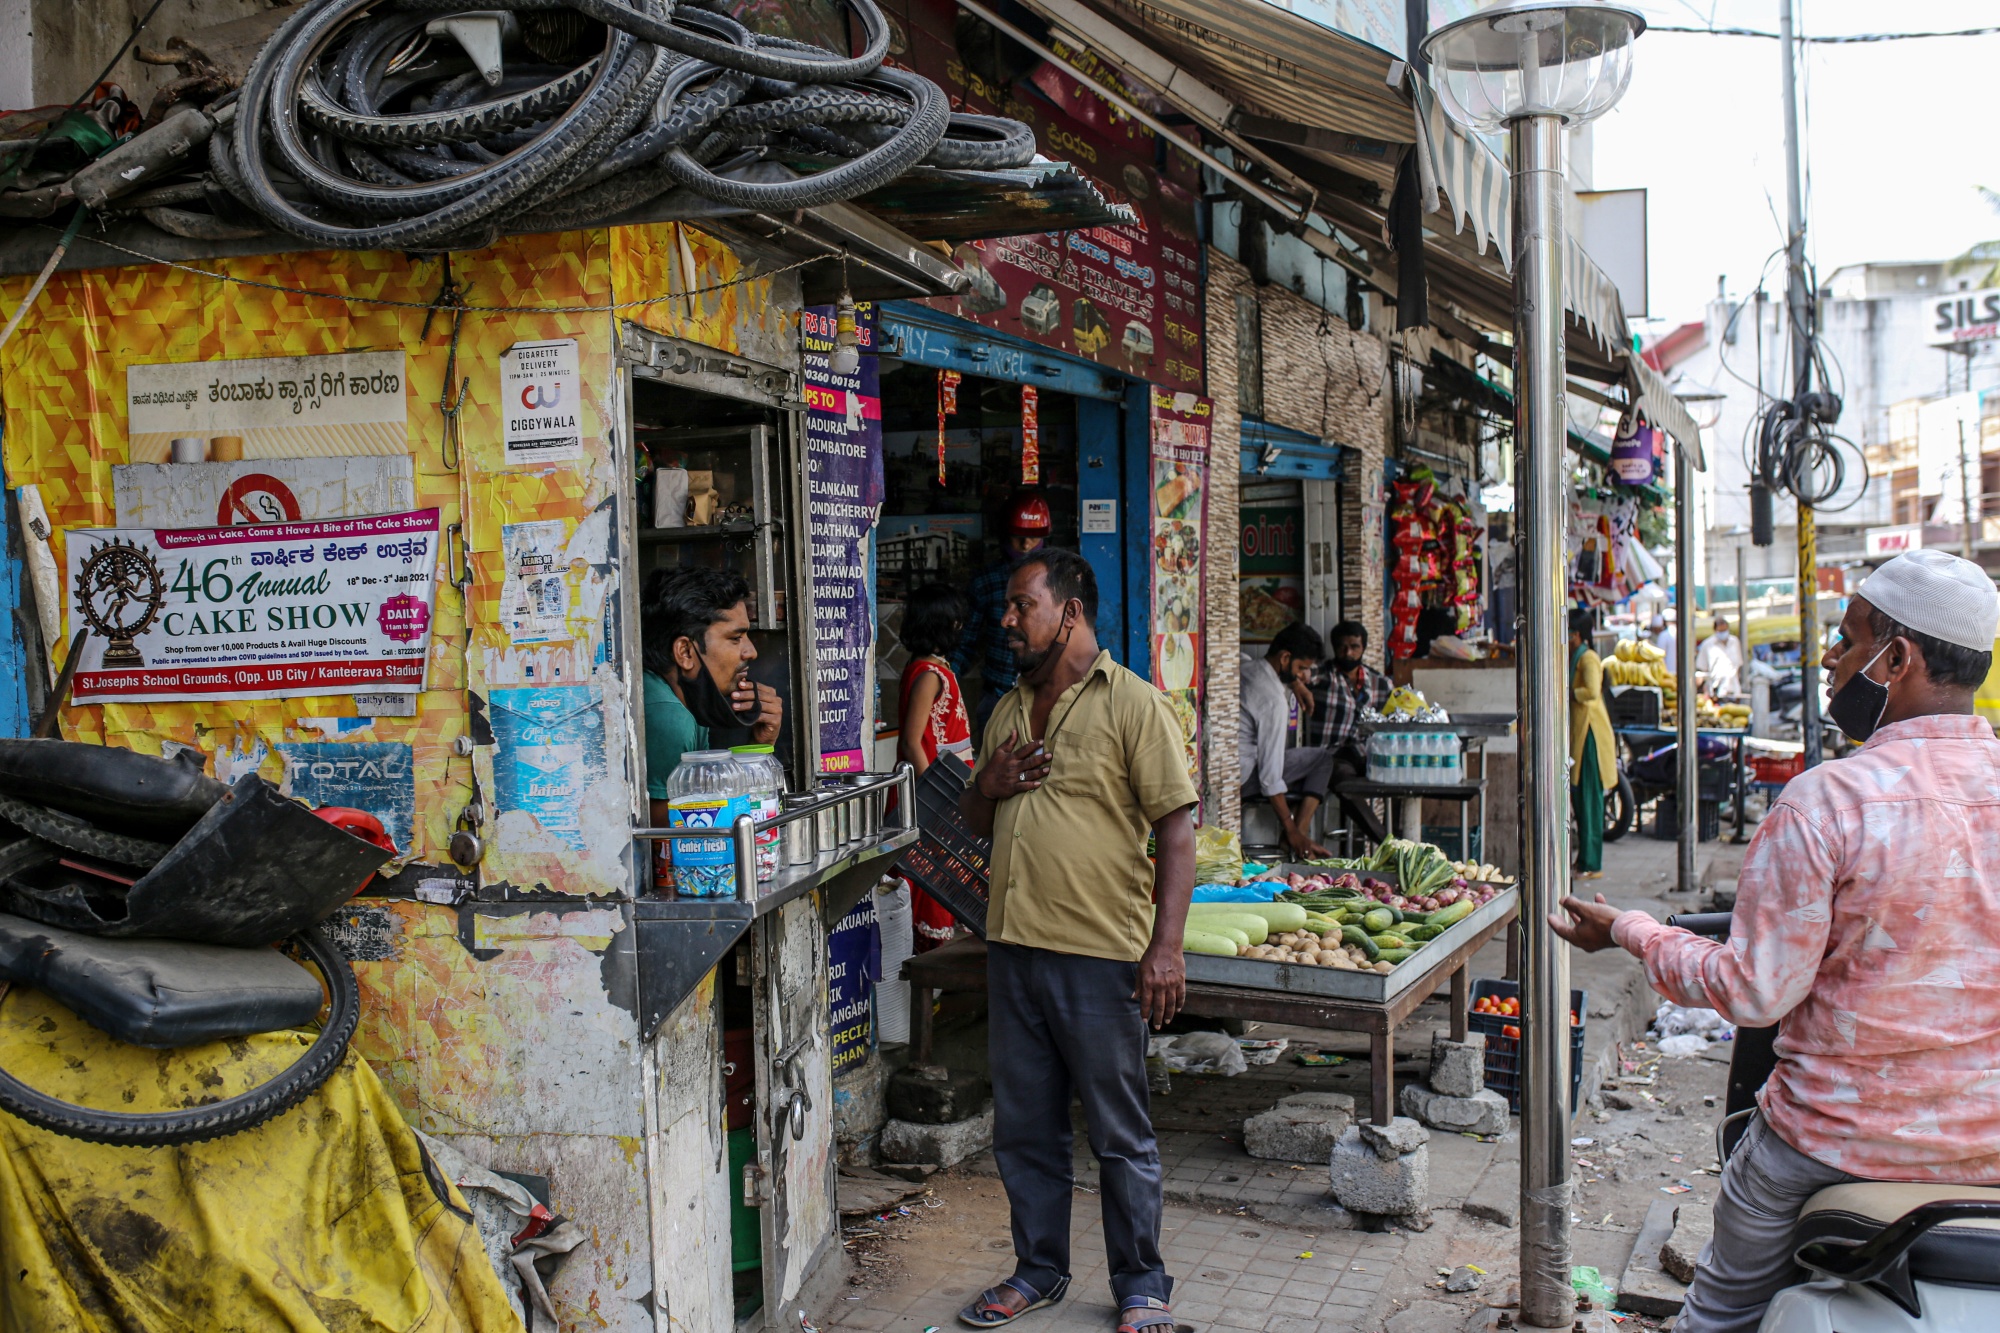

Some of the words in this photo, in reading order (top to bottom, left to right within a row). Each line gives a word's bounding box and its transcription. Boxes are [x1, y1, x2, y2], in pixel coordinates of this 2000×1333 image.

[1092, 227, 1132, 255] DISHES
[1112, 224, 1149, 245] LABLE
[1065, 258, 1078, 276] &
[1081, 265, 1155, 309] TRAVELS
[1081, 281, 1153, 322] TRAVELS)
[805, 311, 818, 333] RS
[820, 316, 827, 336] &
[889, 322, 928, 360] ONLY
[518, 349, 558, 359] CIGARETTE
[804, 353, 829, 368] 9704
[521, 360, 556, 370] DELIVERY
[208, 376, 274, 403] ತಂಬಾಕು
[349, 369, 400, 395] ಕಾರಣ
[805, 369, 829, 383] 0360
[831, 375, 860, 389] 00184
[806, 389, 818, 405] PS
[821, 391, 834, 408] TO
[511, 415, 576, 432] CIGGYWALA
[1182, 423, 1208, 448] RIYA
[807, 437, 867, 459] OIMBATORE
[809, 480, 859, 498] ELANKANI
[810, 501, 875, 519] ONDICHERRY
[247, 526, 275, 537] Come
[276, 526, 284, 536] &
[285, 525, 310, 535] Have
[313, 524, 321, 533] A
[323, 523, 341, 532] Bite
[344, 521, 354, 531] of
[356, 520, 373, 530] The
[375, 519, 401, 529] Cake
[403, 516, 433, 527] Show
[811, 522, 861, 538] URATHKAL
[1241, 514, 1295, 556] oint
[251, 544, 315, 568] ವಾರ್ಷಿಕ
[323, 543, 368, 562] ಕೇಕ್
[376, 537, 428, 564] ಉತ್ಸವ
[811, 543, 845, 557] IJAPUR
[523, 555, 543, 565] YEARS
[543, 555, 552, 564] OF
[362, 576, 377, 585] Dec
[394, 575, 409, 583] Jan
[410, 573, 429, 582] 2021
[812, 564, 862, 579] IJAYAWAD
[236, 567, 331, 605] Annual
[813, 586, 855, 599] HARWAD
[163, 609, 257, 637] CAKE
[267, 602, 371, 632] SHOW
[387, 608, 419, 620] DAILY
[814, 606, 847, 620] ARWAR
[385, 623, 402, 631] 11am
[815, 627, 844, 640] OLLAM
[164, 646, 184, 655] Shop
[185, 645, 202, 653] from
[221, 643, 244, 652] 10,000
[246, 641, 279, 650] Products
[288, 639, 306, 648] Avail
[308, 639, 327, 648] Huge
[329, 637, 367, 646] Discounts
[816, 647, 868, 661] ANTRALAY
[181, 656, 210, 665] requested
[239, 653, 257, 661] COVID
[258, 651, 288, 661] guidelines
[334, 650, 341, 658] by
[142, 675, 180, 686] School
[182, 672, 232, 685] Grounds,
[234, 669, 264, 685] (Opp.
[267, 669, 283, 681] UB
[286, 668, 307, 682] City
[318, 666, 383, 678] Kanteerava
[817, 668, 848, 682] AYNAD
[818, 690, 850, 703] ATKAL
[819, 709, 847, 724] LICUT
[291, 761, 404, 780] TOTAL
[826, 755, 850, 770] TOUR
[677, 838, 702, 853] Center
[704, 838, 727, 852] fresh
[829, 962, 847, 982] RDI
[833, 1043, 865, 1070] SHAN
